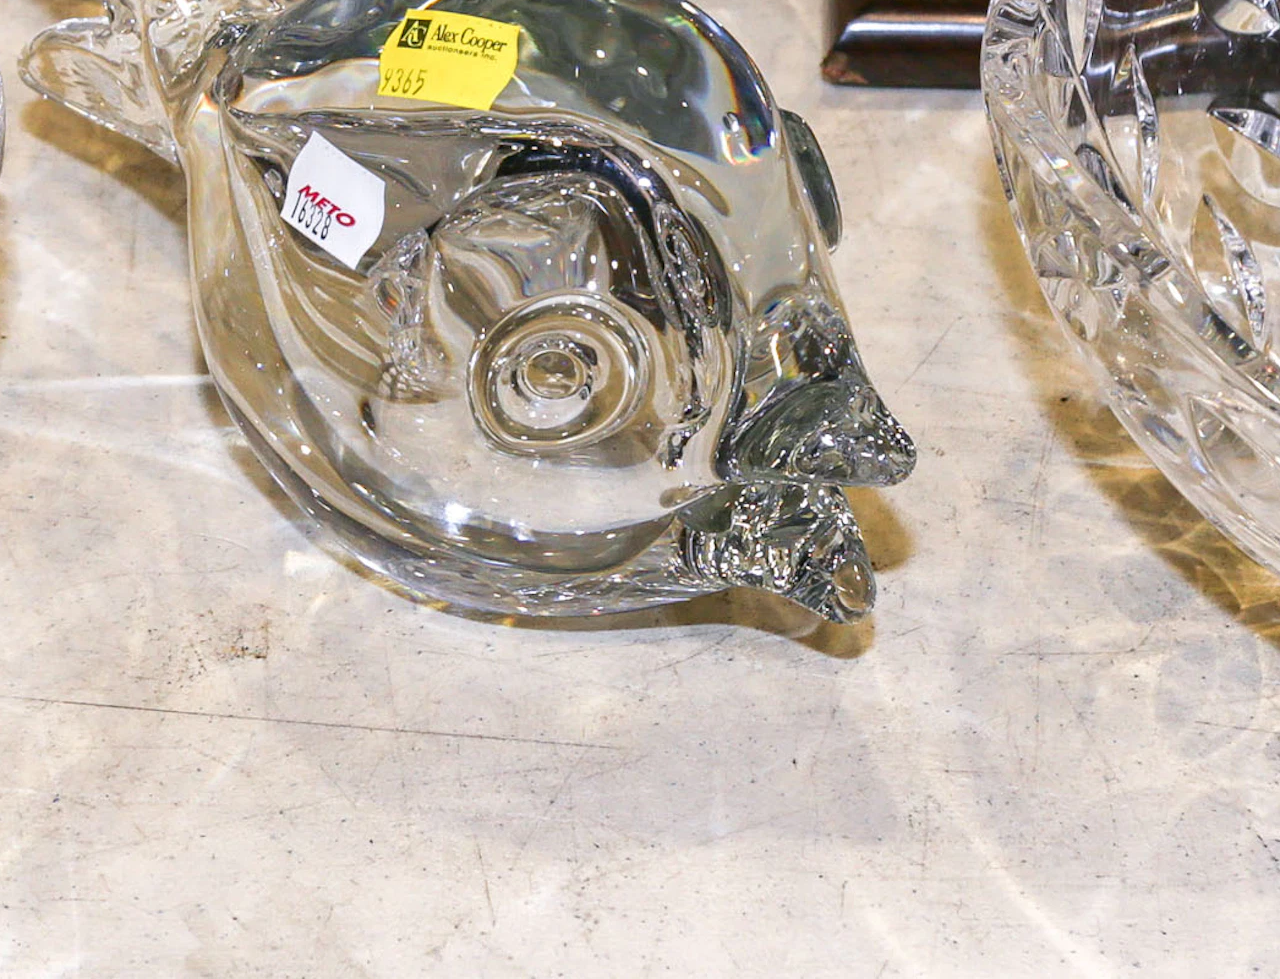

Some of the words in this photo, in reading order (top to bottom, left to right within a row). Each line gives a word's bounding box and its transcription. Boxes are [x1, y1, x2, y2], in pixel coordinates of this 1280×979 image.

[427, 44, 478, 57] auctioneers
[431, 24, 459, 44] Alex
[461, 27, 508, 53] Cooper
[291, 193, 332, 240] 16328
[298, 184, 356, 227] METO
